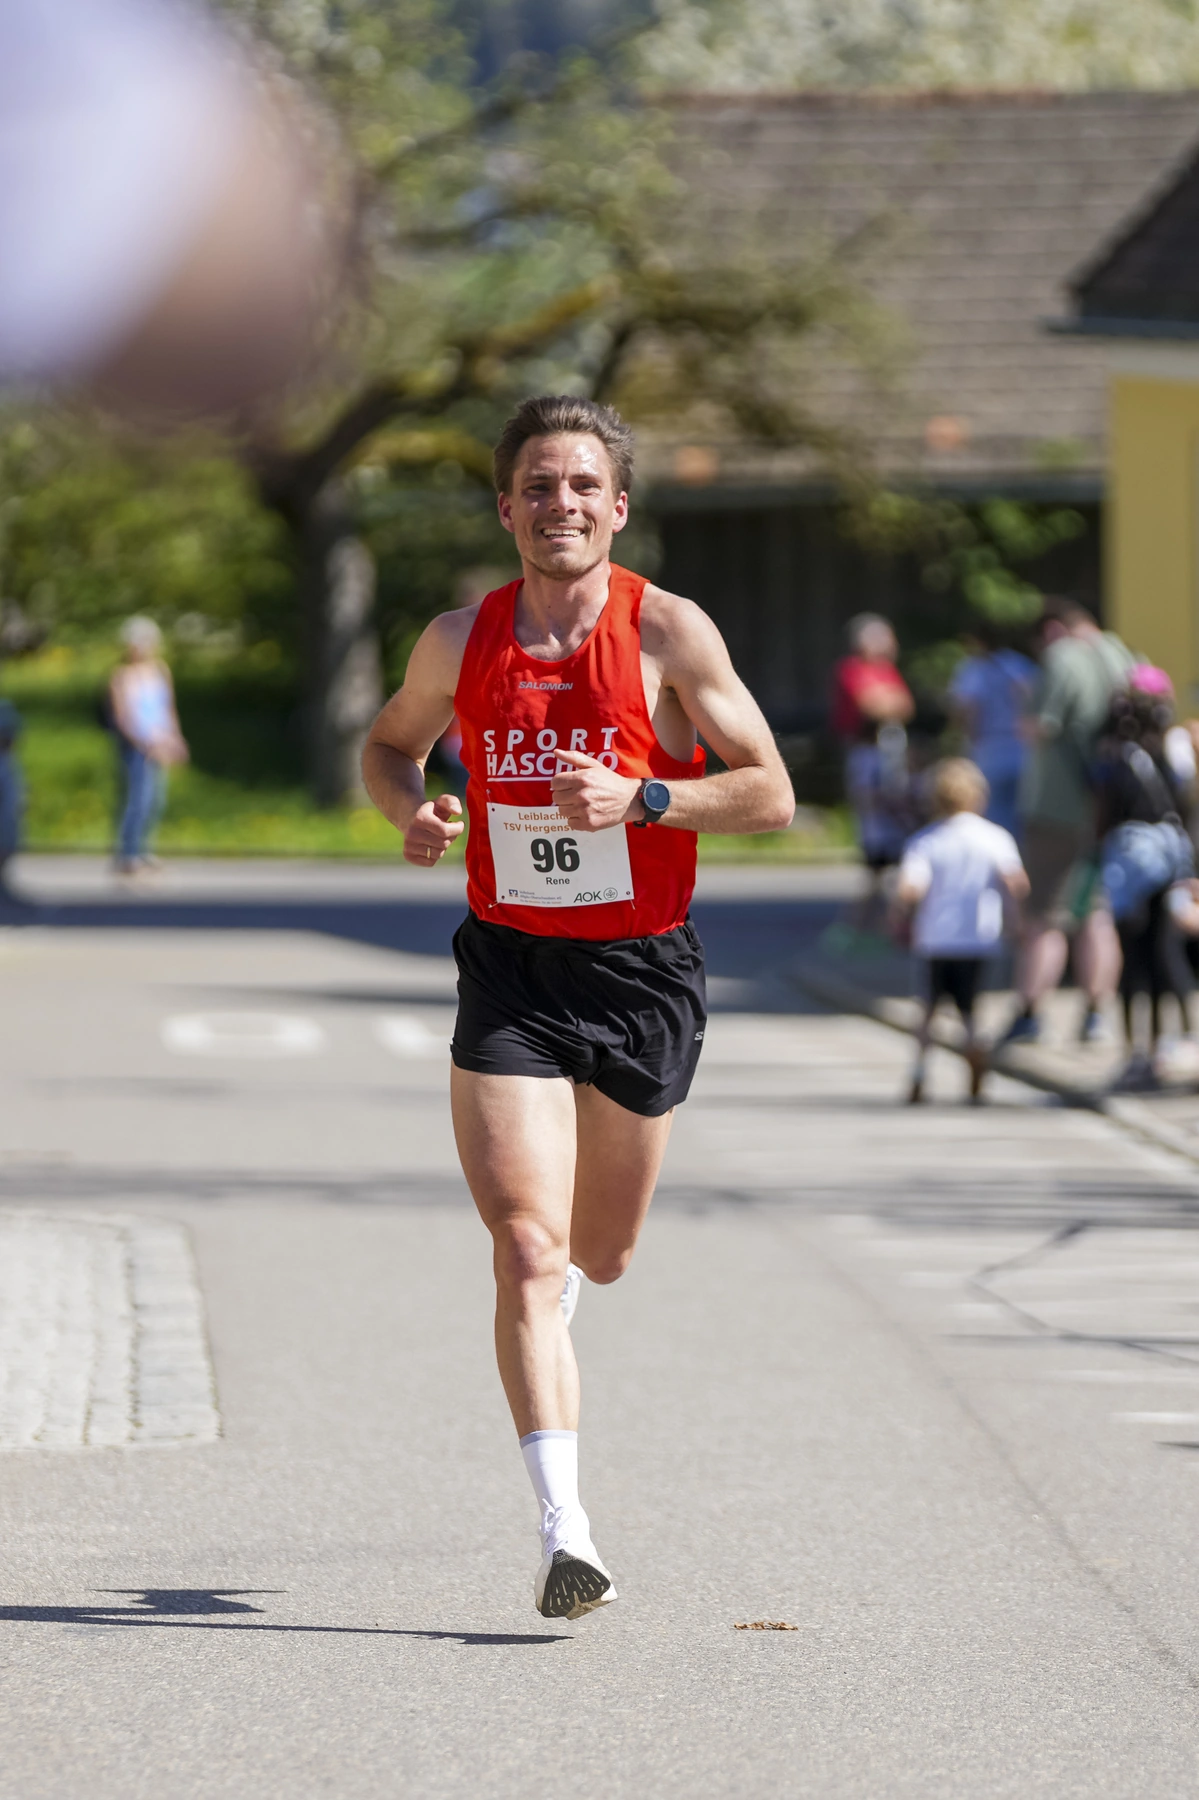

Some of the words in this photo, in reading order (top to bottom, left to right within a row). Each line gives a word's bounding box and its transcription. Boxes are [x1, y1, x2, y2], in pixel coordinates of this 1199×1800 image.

[519, 681, 573, 690] SALOMON
[483, 727, 618, 752] SPORT
[486, 751, 618, 776] HASCHO
[503, 822, 521, 831] TSV
[525, 824, 573, 834] Hergens
[530, 837, 580, 872] 96
[546, 877, 570, 885] Rene
[574, 891, 602, 903] AOK
